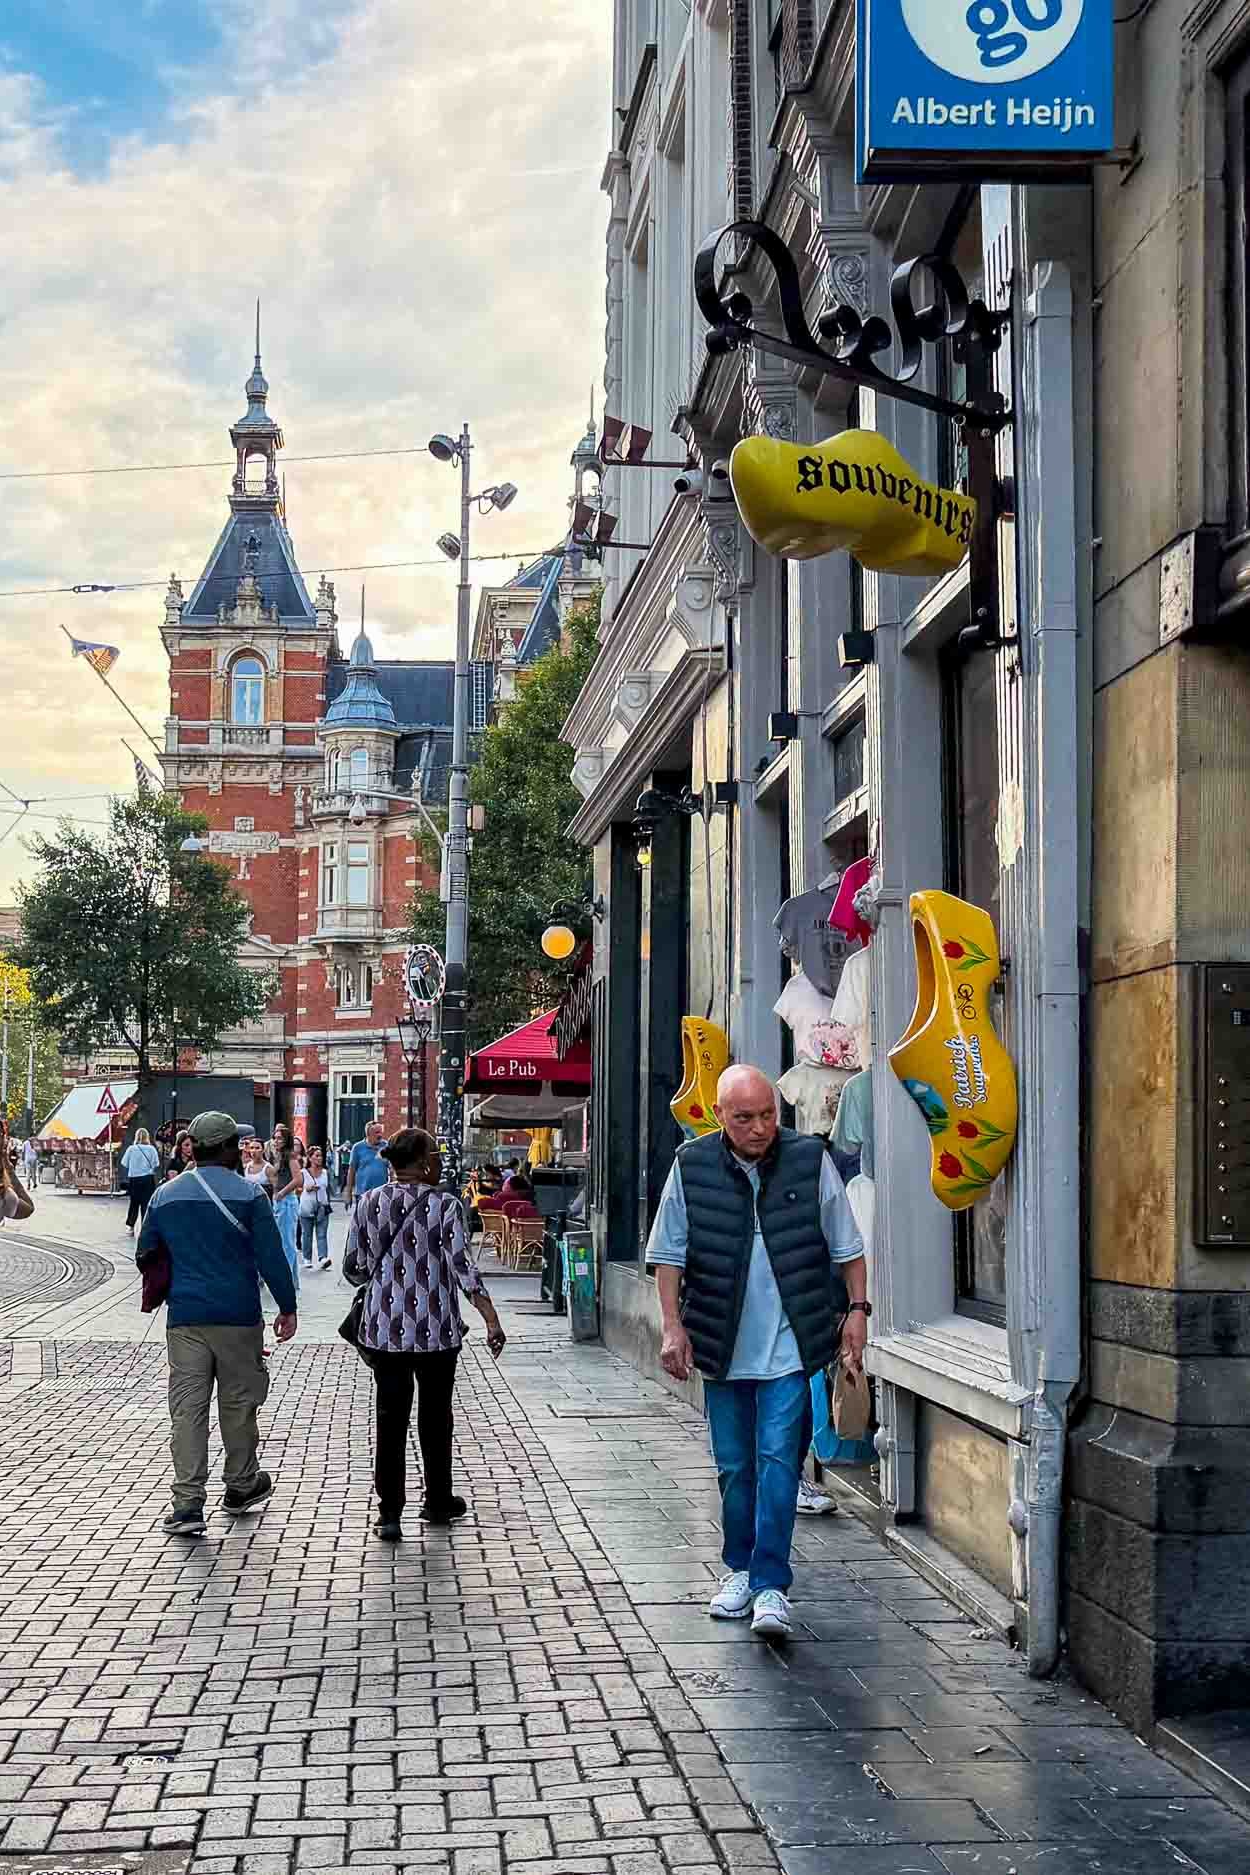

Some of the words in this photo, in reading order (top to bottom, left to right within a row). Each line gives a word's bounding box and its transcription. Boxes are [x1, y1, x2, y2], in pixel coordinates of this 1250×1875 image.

[891, 97, 996, 125] Albert
[1006, 97, 1095, 133] Heijn
[488, 1060, 506, 1076] Le
[509, 1060, 537, 1076] Pub
[943, 1034, 973, 1109] Patrick
